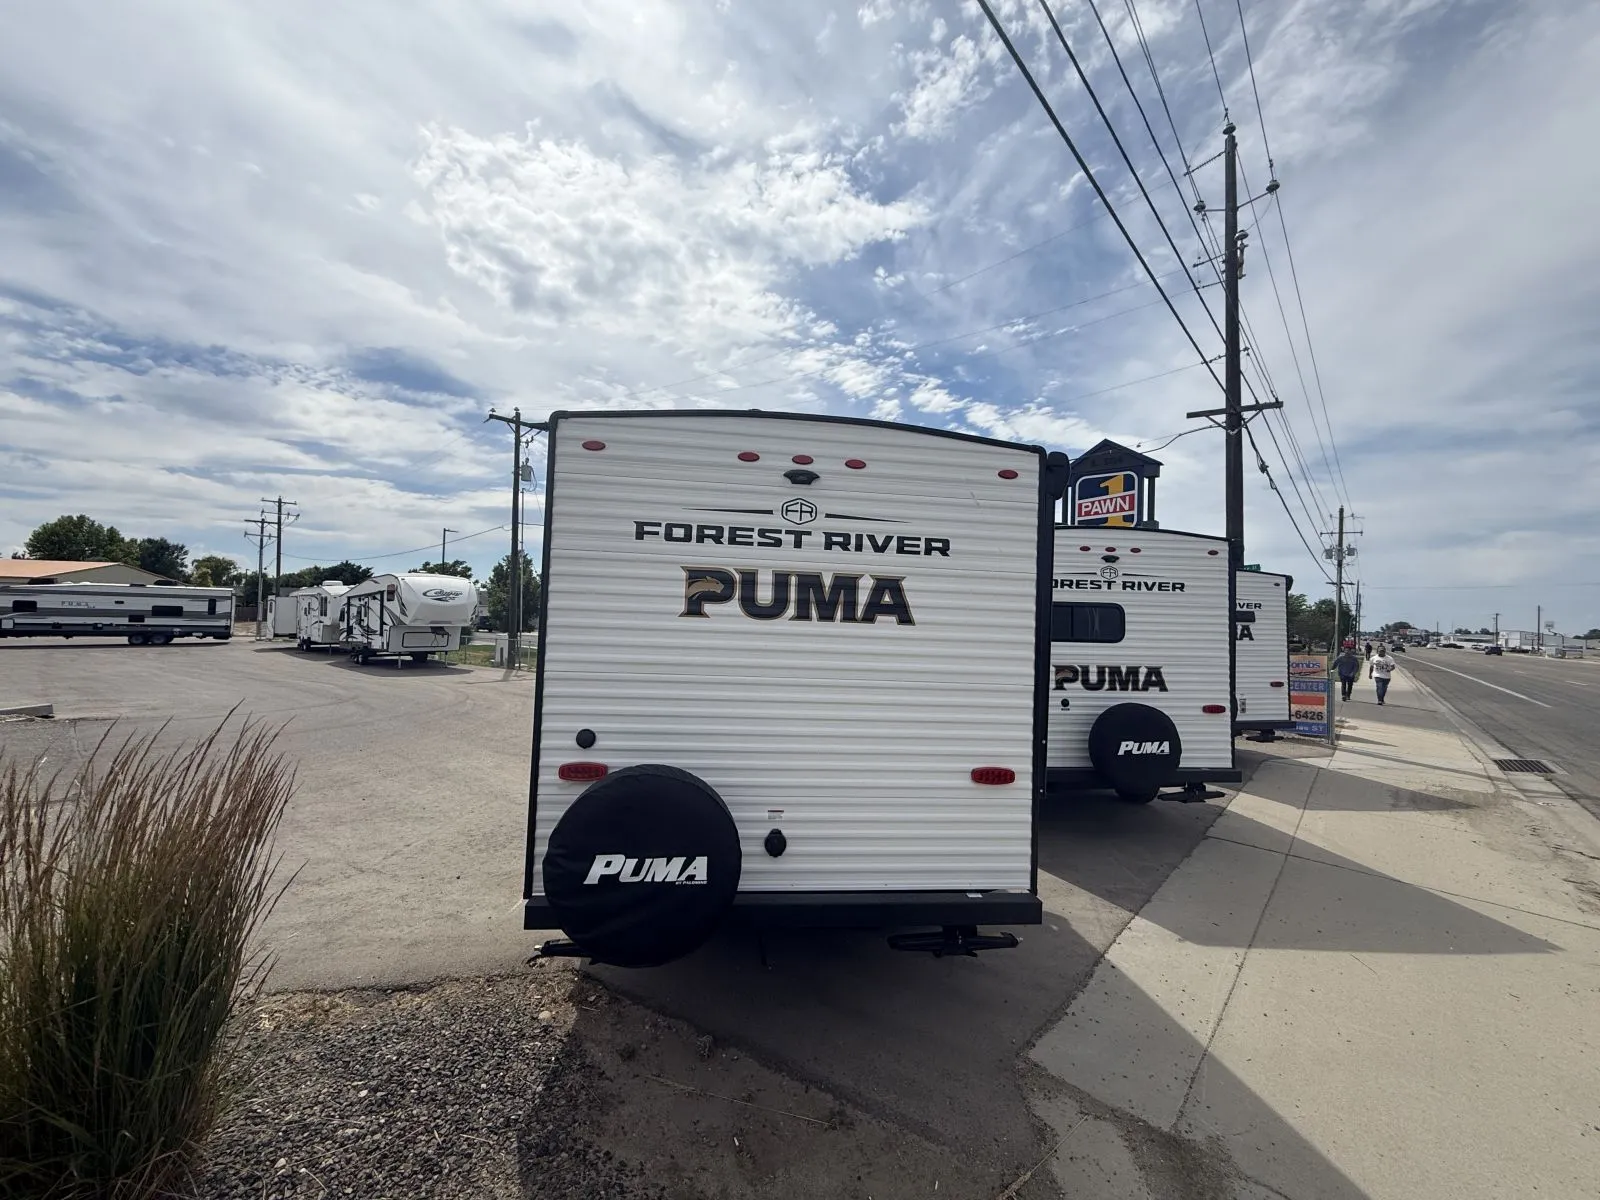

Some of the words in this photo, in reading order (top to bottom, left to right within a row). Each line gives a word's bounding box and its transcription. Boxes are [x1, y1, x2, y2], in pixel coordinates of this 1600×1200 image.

[1081, 495, 1130, 516] PAWN
[633, 520, 812, 549] FOREST
[822, 531, 951, 557] RIVER
[678, 565, 916, 626] PUMA
[1052, 579, 1116, 590] REST
[1121, 580, 1185, 592] RIVER
[1291, 660, 1321, 669] ombs
[1052, 665, 1169, 692] PUMA
[1291, 710, 1324, 721] -6426
[1117, 741, 1170, 755] PUMA
[583, 854, 708, 885] PUMA
